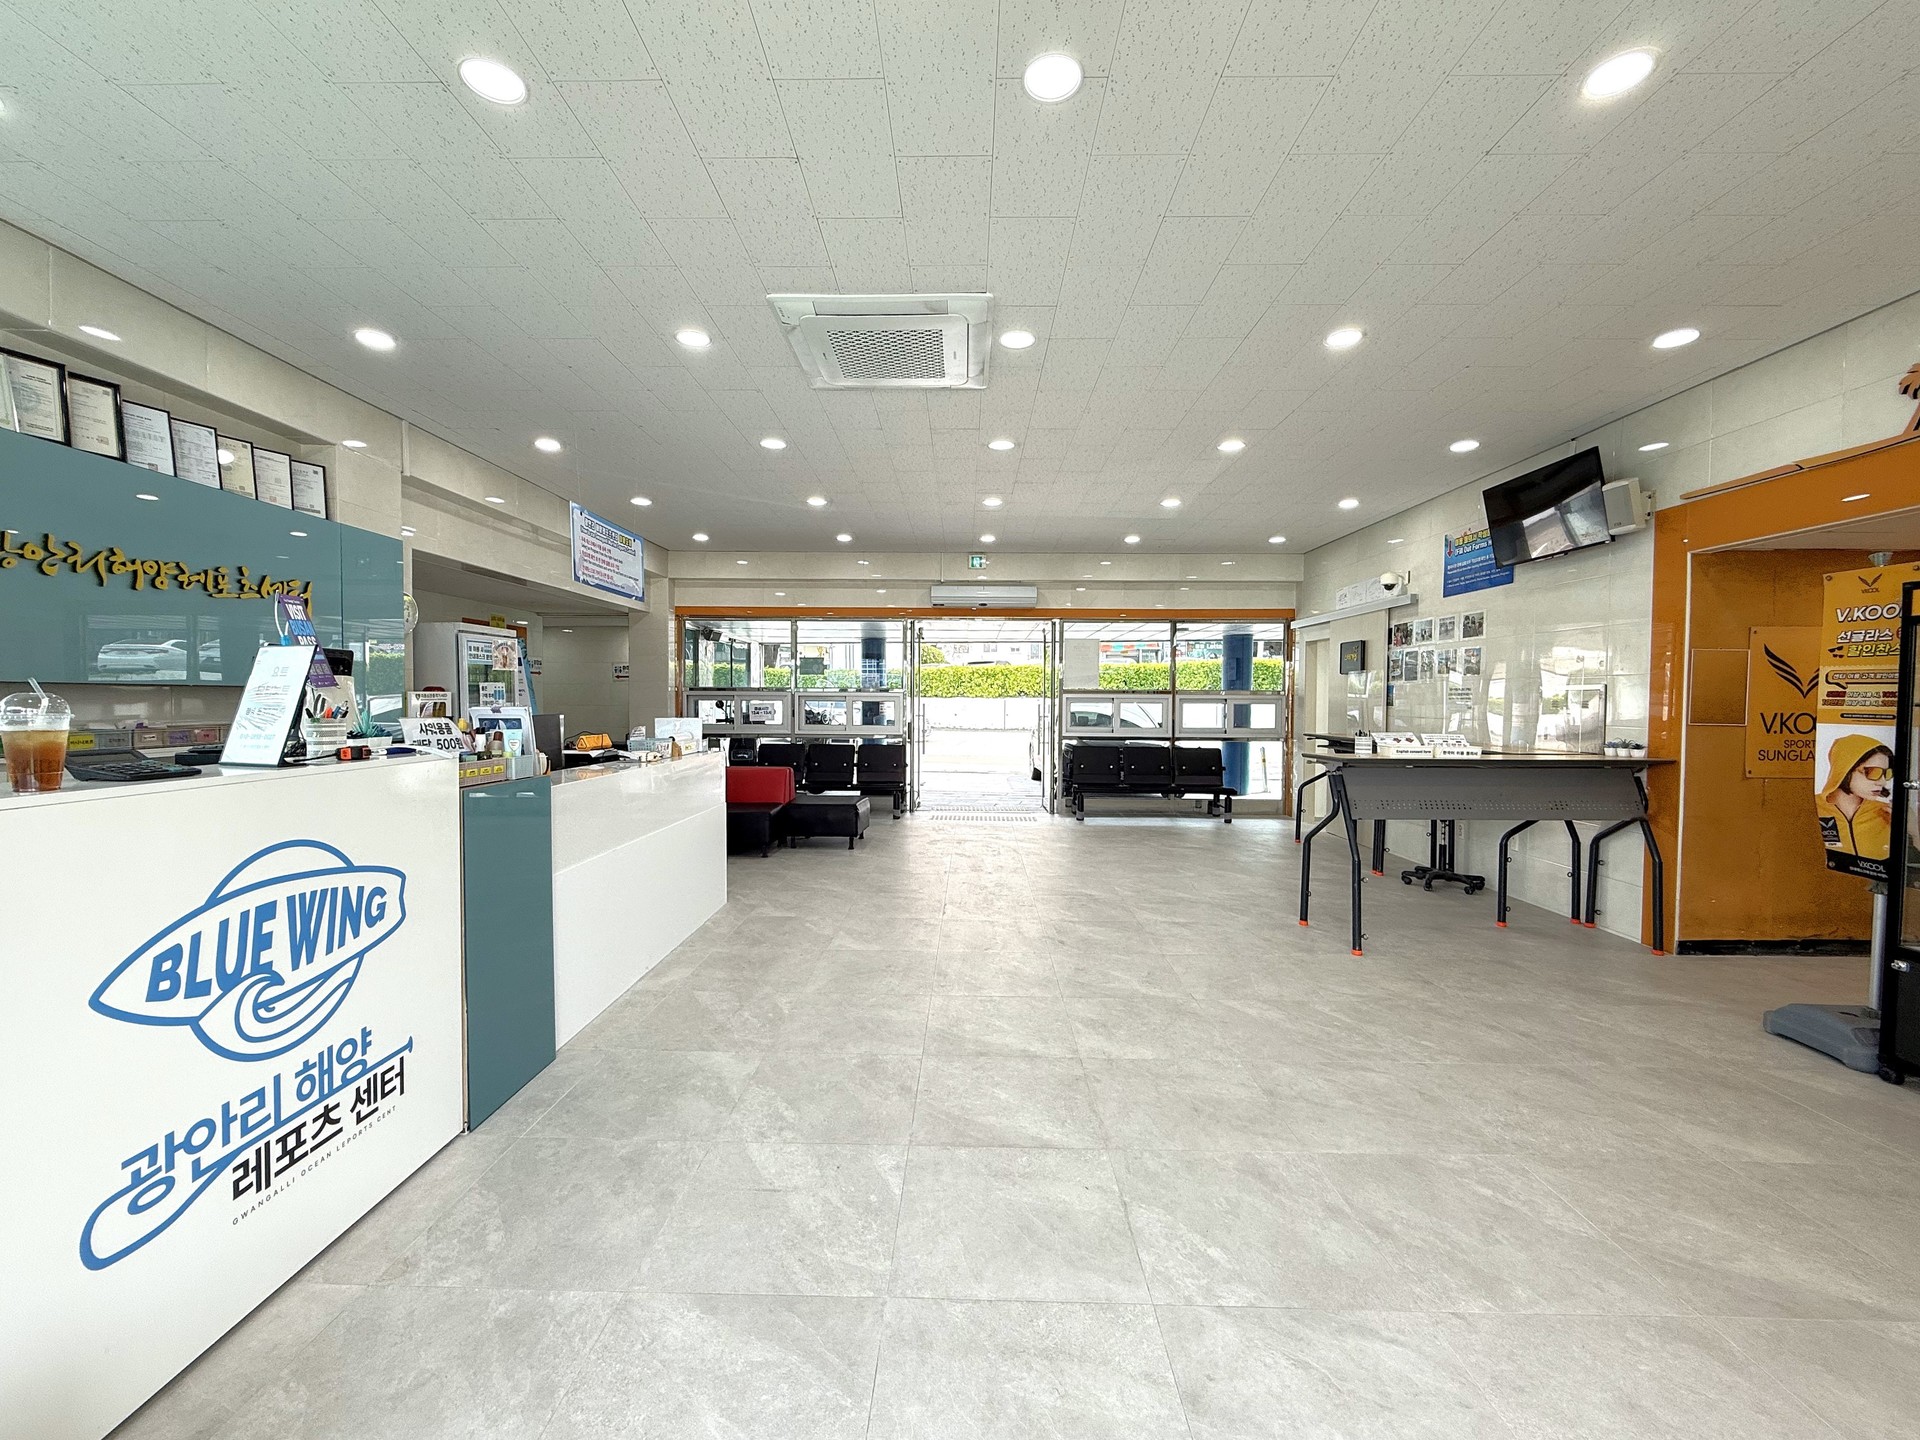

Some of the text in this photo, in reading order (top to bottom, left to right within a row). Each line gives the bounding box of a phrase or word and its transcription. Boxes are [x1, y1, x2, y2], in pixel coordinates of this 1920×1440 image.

[285, 603, 307, 621] VISIT
[1836, 603, 1902, 622] V.KOO
[1837, 629, 1893, 643] 선글라스
[419, 722, 453, 736] 샤워용품
[1760, 712, 1817, 734] V.KO
[1758, 749, 1815, 761] SUNGLA
[145, 885, 387, 1002] BLUE WING
[121, 1026, 373, 1216] 광안리 해양
[232, 1056, 405, 1201] 레포츠 센터
[232, 1104, 397, 1225] GWANGALLI OCEAN LEPORTS CENT
